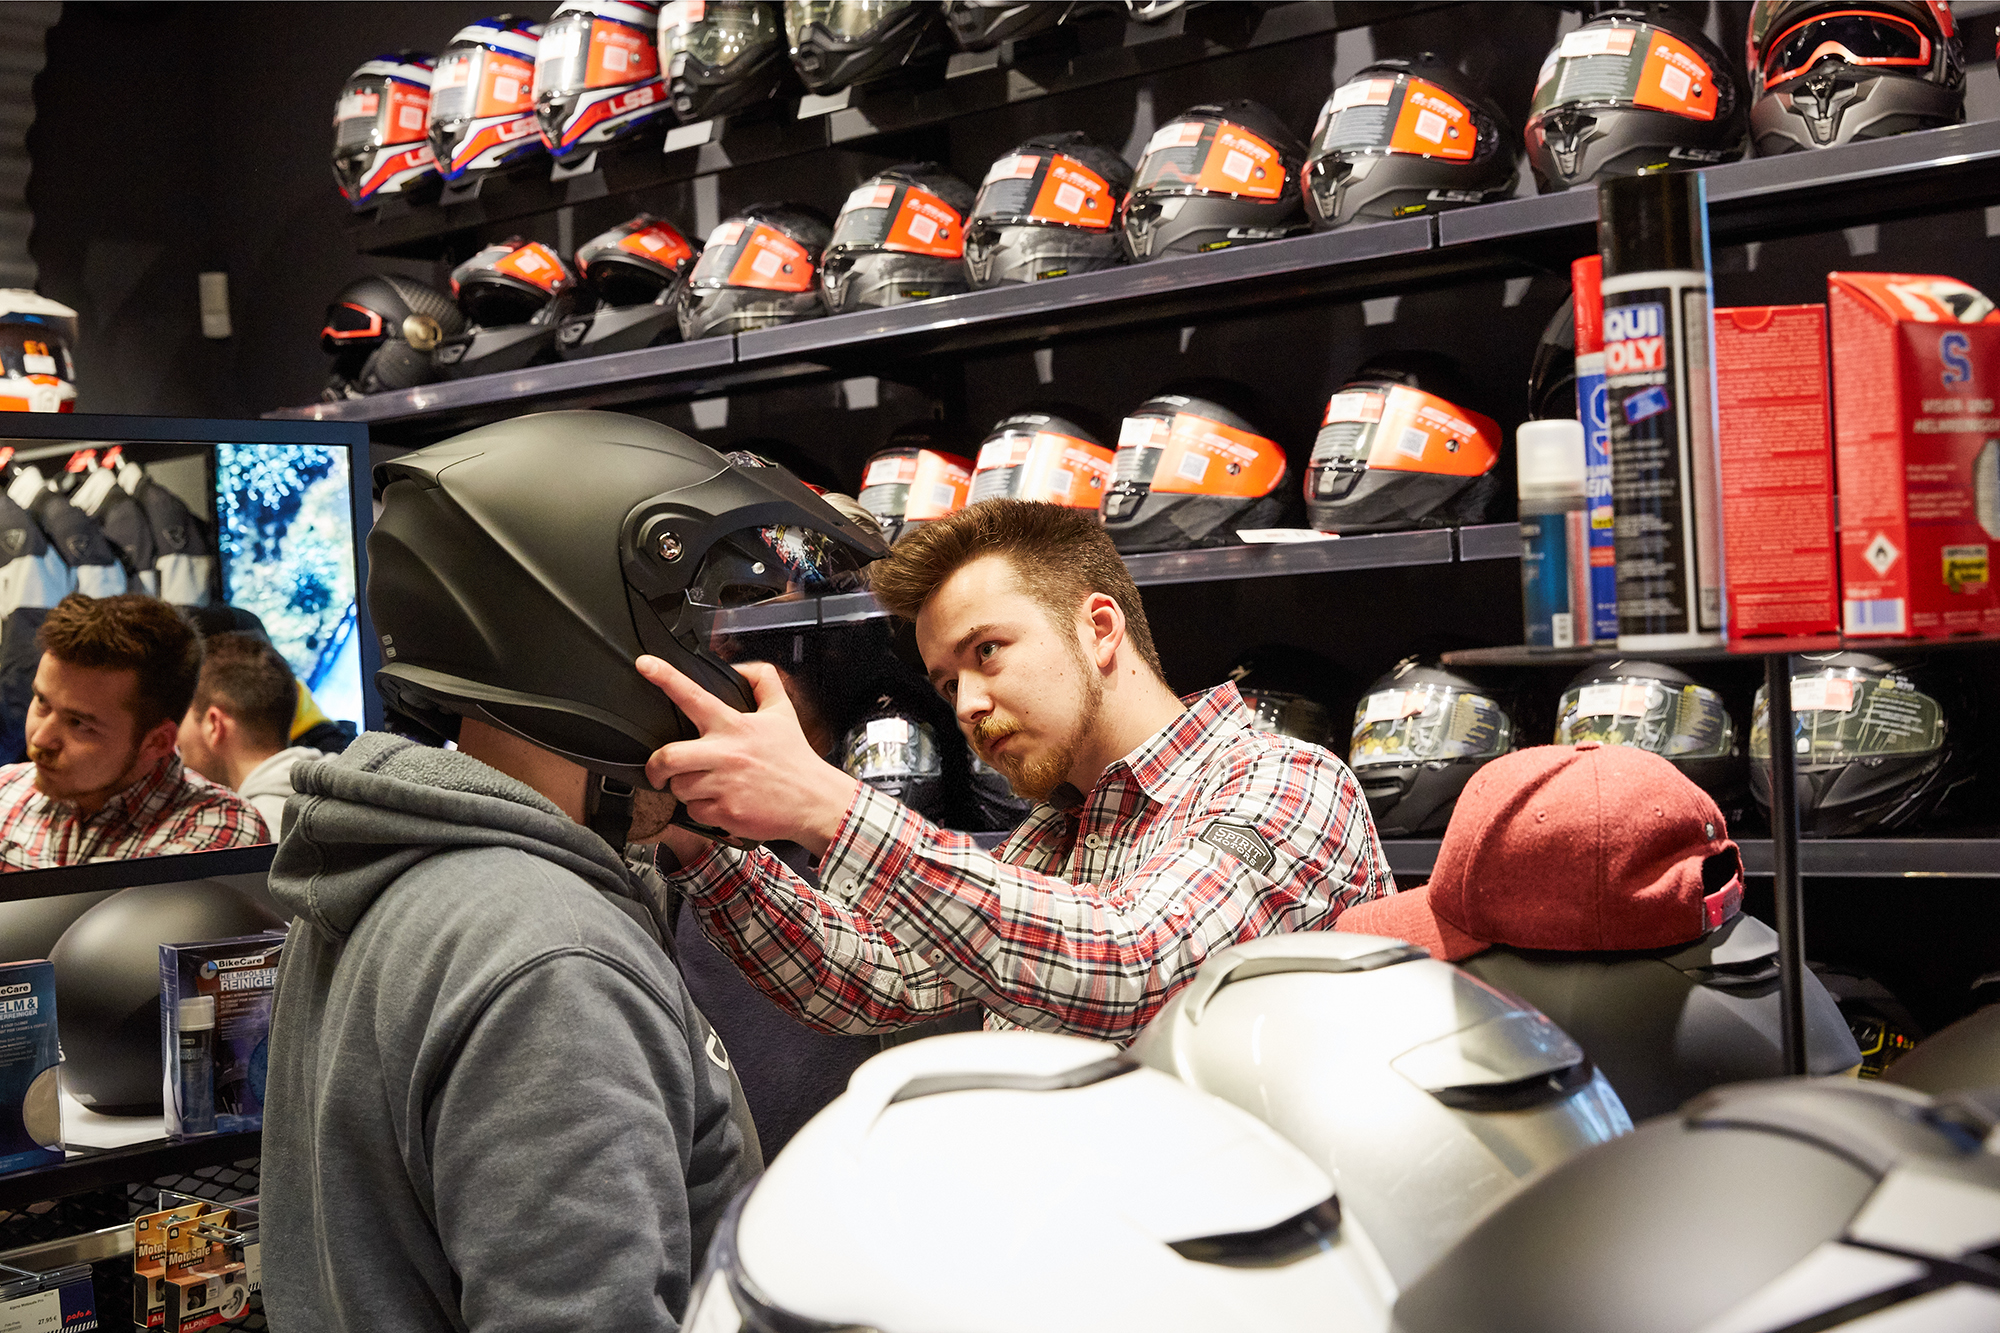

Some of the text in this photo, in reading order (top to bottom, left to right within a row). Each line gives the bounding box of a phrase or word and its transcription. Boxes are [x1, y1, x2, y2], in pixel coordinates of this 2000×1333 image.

[608, 86, 655, 114] LS2
[1668, 147, 1723, 162] LS2
[1606, 339, 1660, 372] OLY
[1212, 835, 1257, 867] MOTORS
[1215, 828, 1263, 860] SPIRIT
[218, 958, 263, 967] BikeCare
[27, 998, 36, 1009] &
[169, 1246, 211, 1266] MotoSafe
[37, 1316, 53, 1326] 27,95
[65, 1310, 84, 1323] polo
